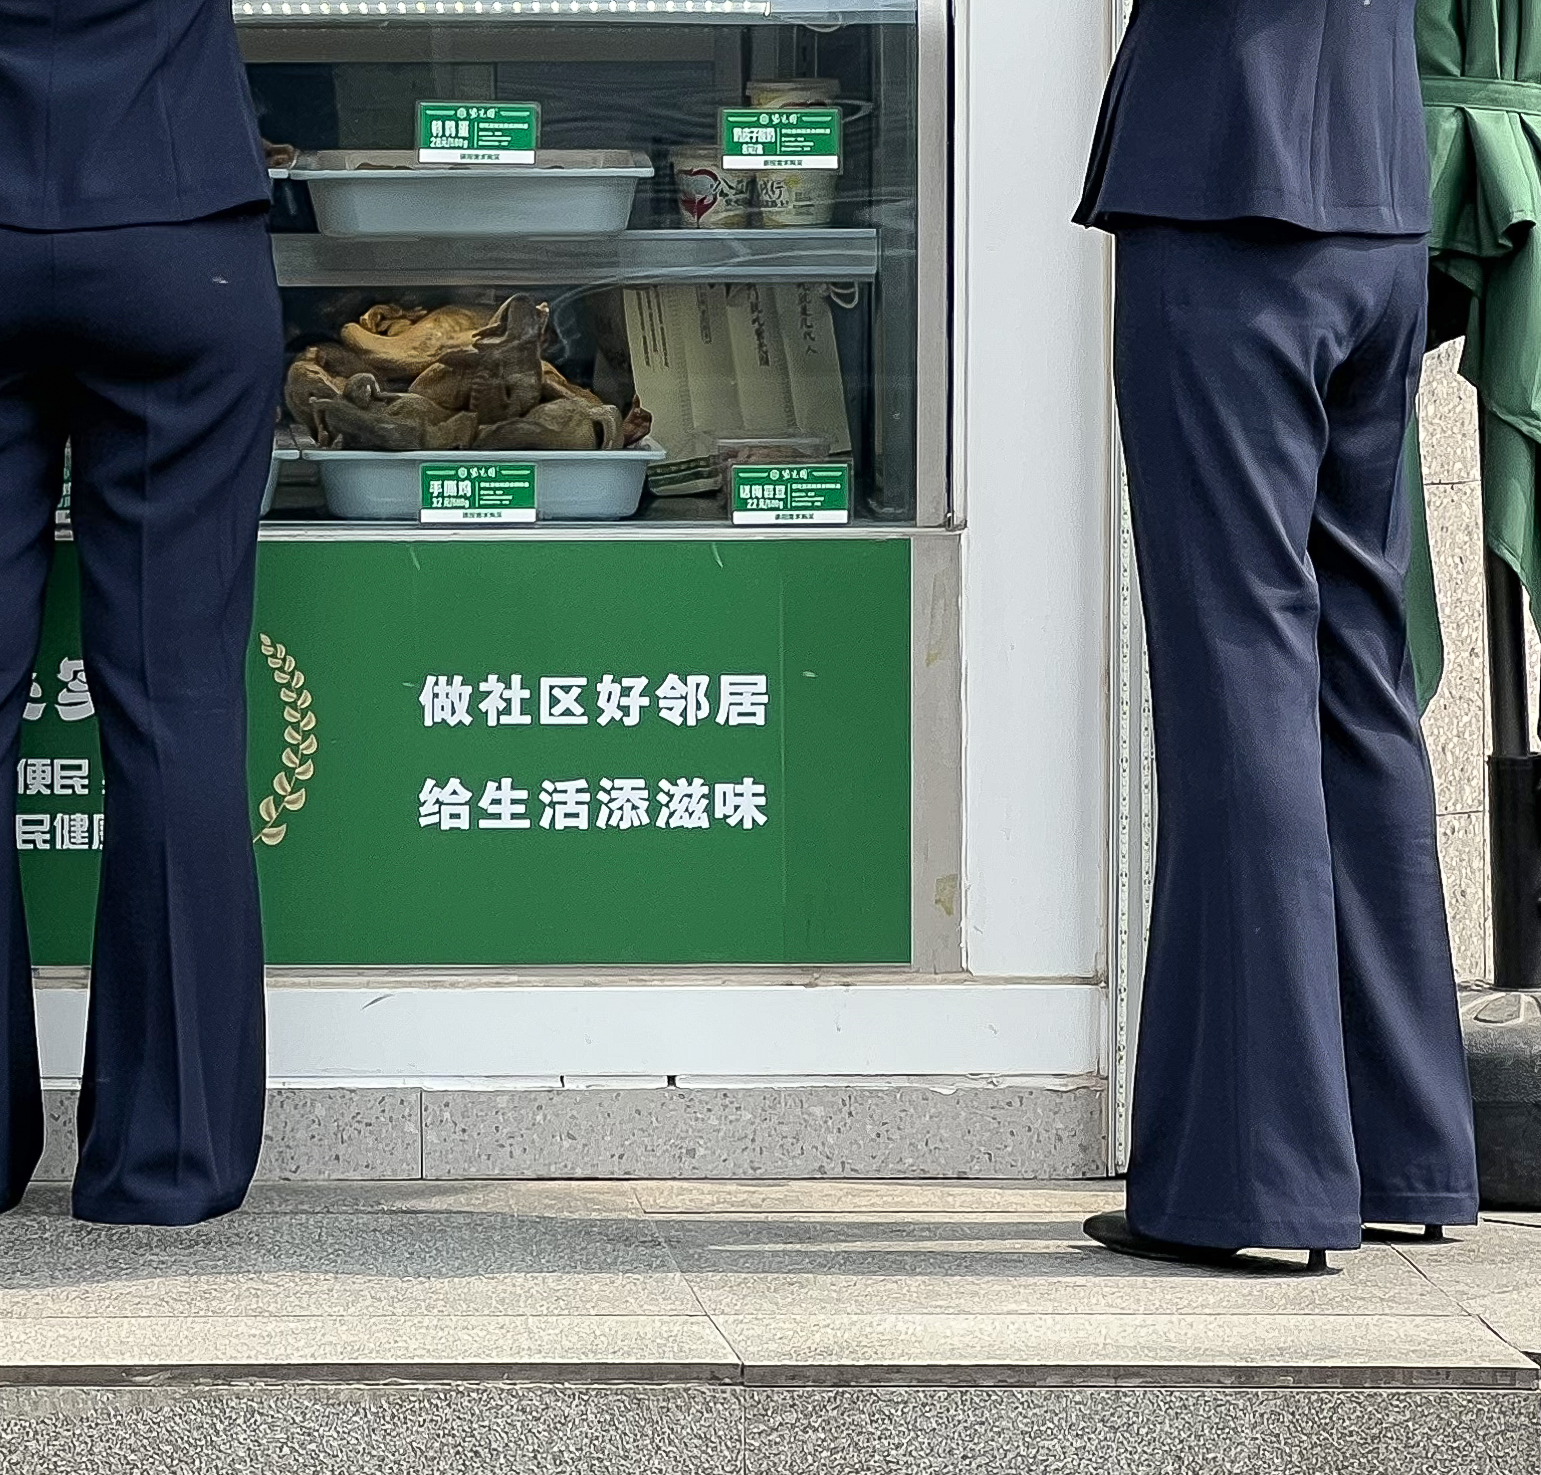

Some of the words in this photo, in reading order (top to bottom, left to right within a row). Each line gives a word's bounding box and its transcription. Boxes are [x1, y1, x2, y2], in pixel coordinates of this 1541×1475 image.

[418, 672, 770, 727] 做社区好邻居
[16, 757, 90, 795] 便民
[417, 776, 769, 830] 给生活添滋味
